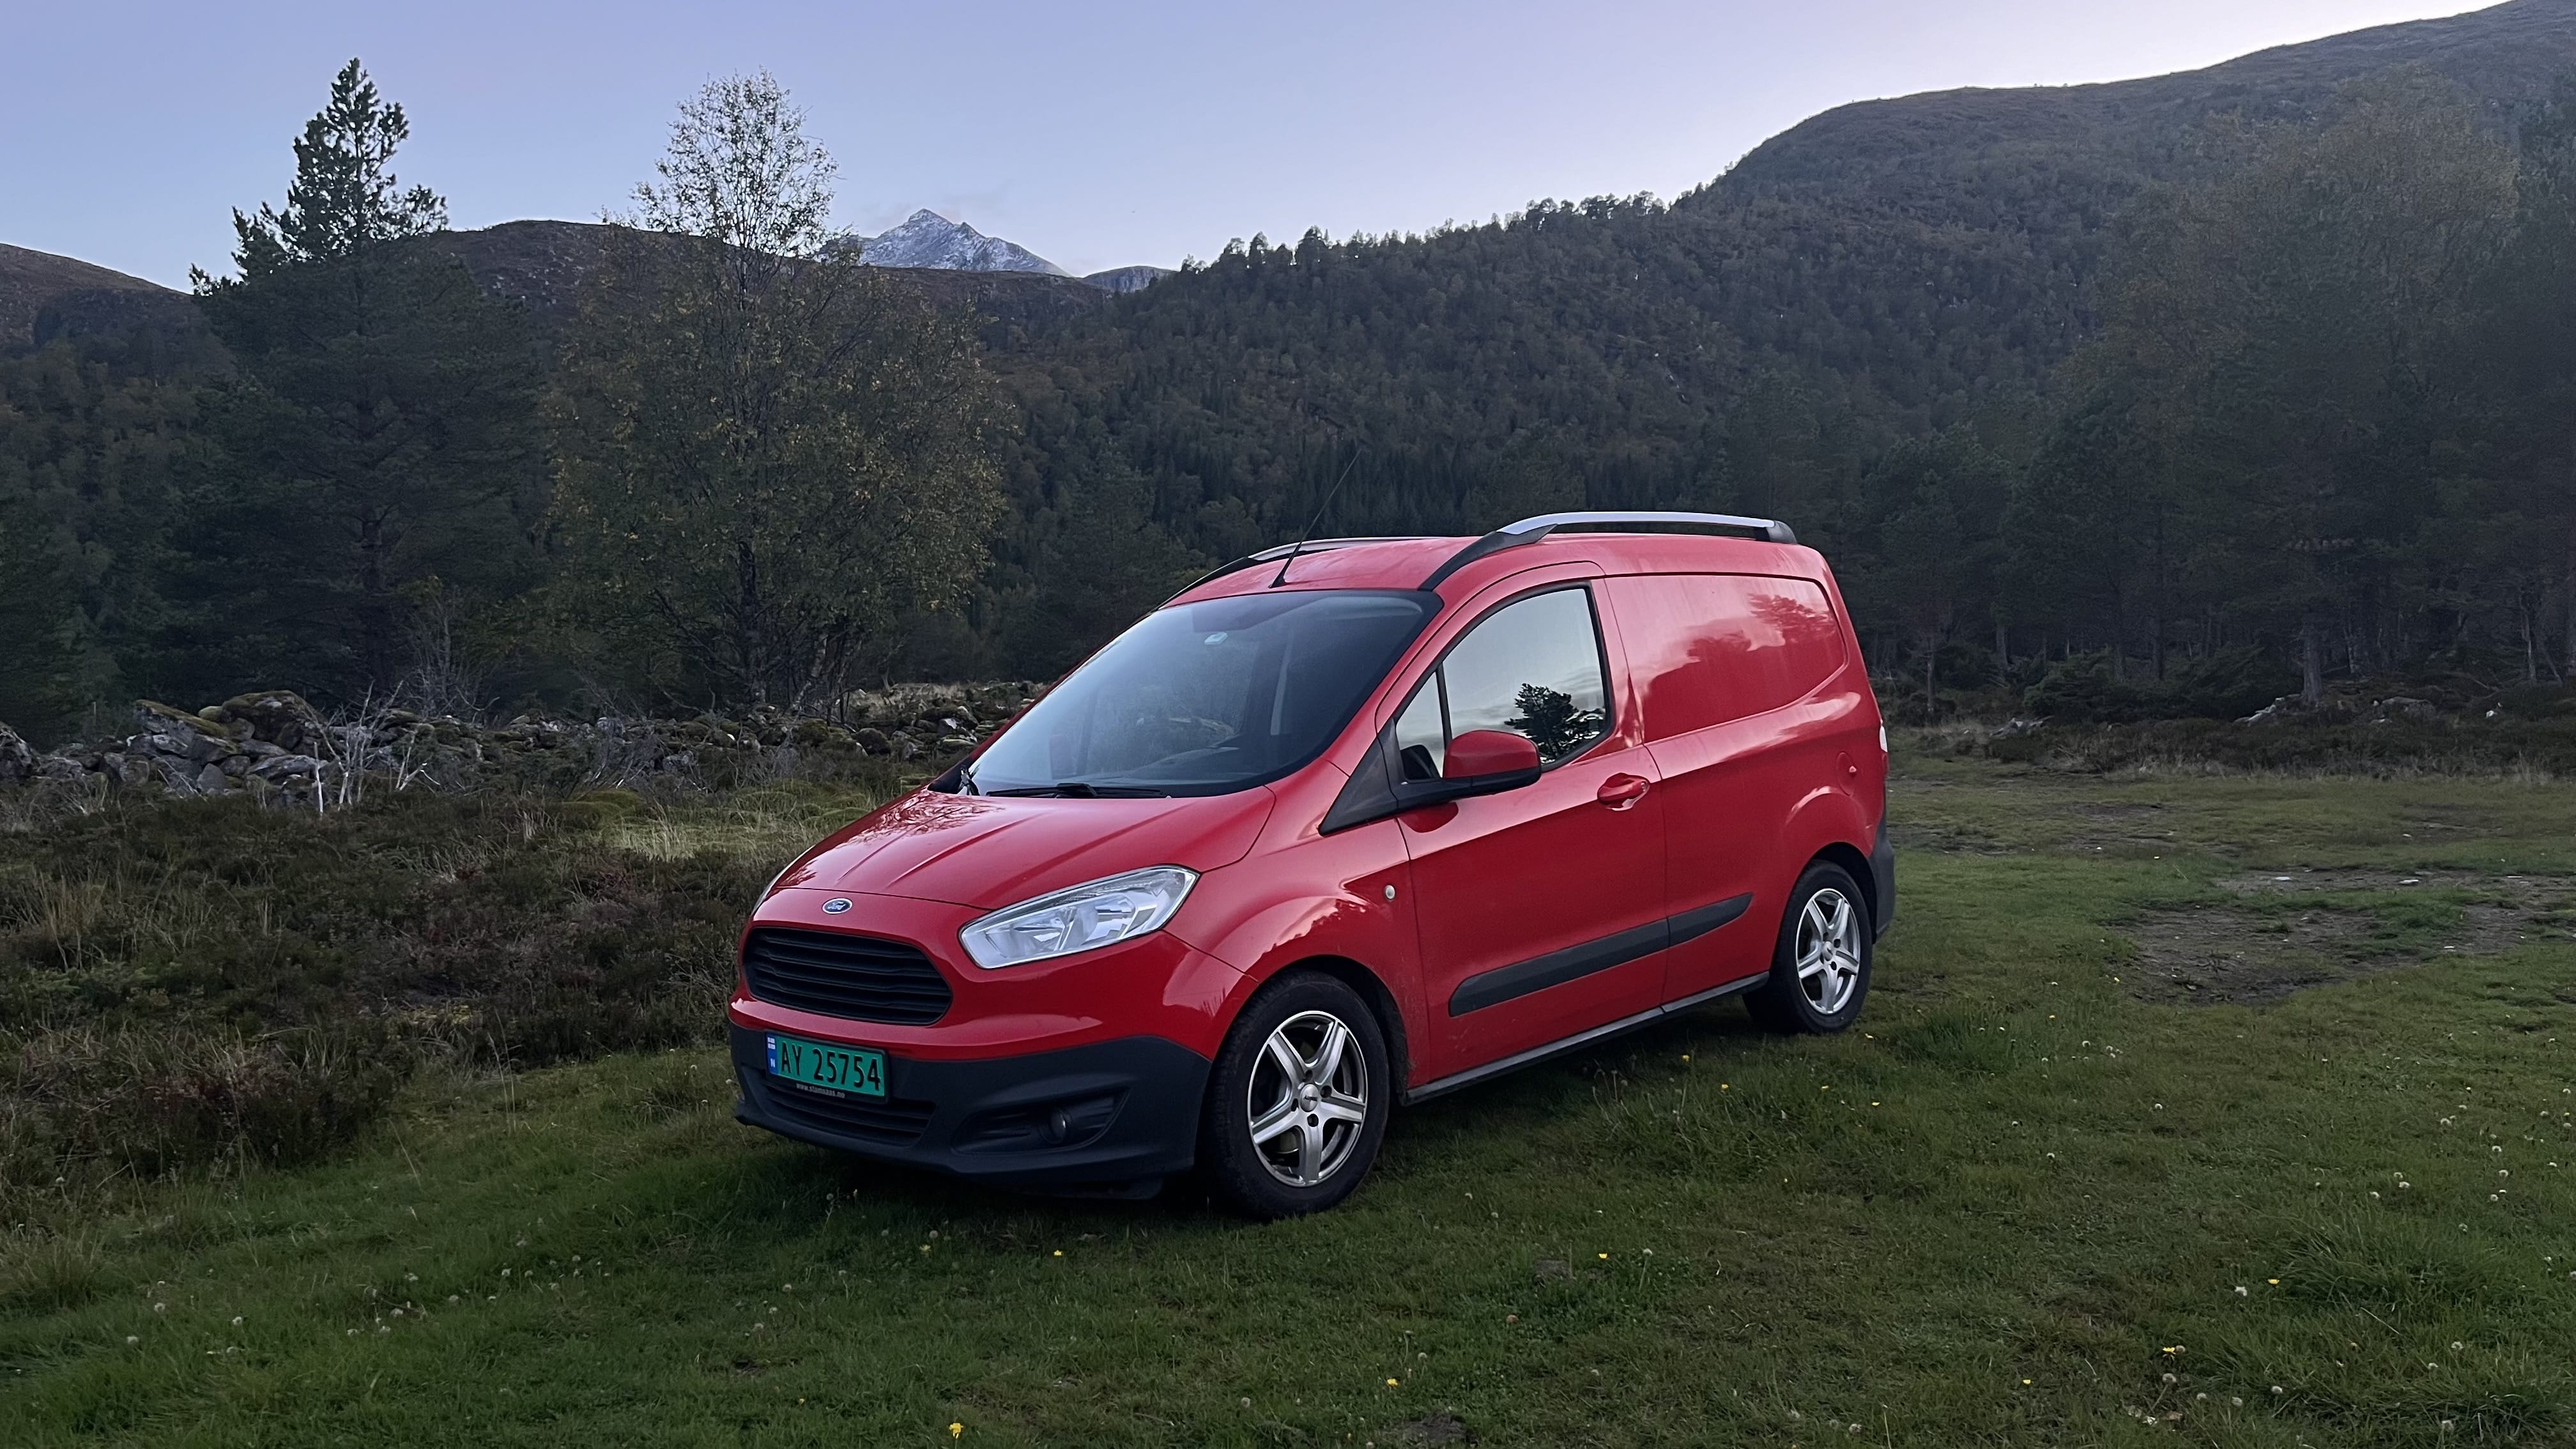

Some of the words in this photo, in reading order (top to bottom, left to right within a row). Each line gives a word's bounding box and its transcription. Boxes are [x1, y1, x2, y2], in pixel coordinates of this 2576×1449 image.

[770, 1058, 776, 1068] N
[781, 1041, 802, 1076] AY
[812, 1048, 880, 1091] 25754
